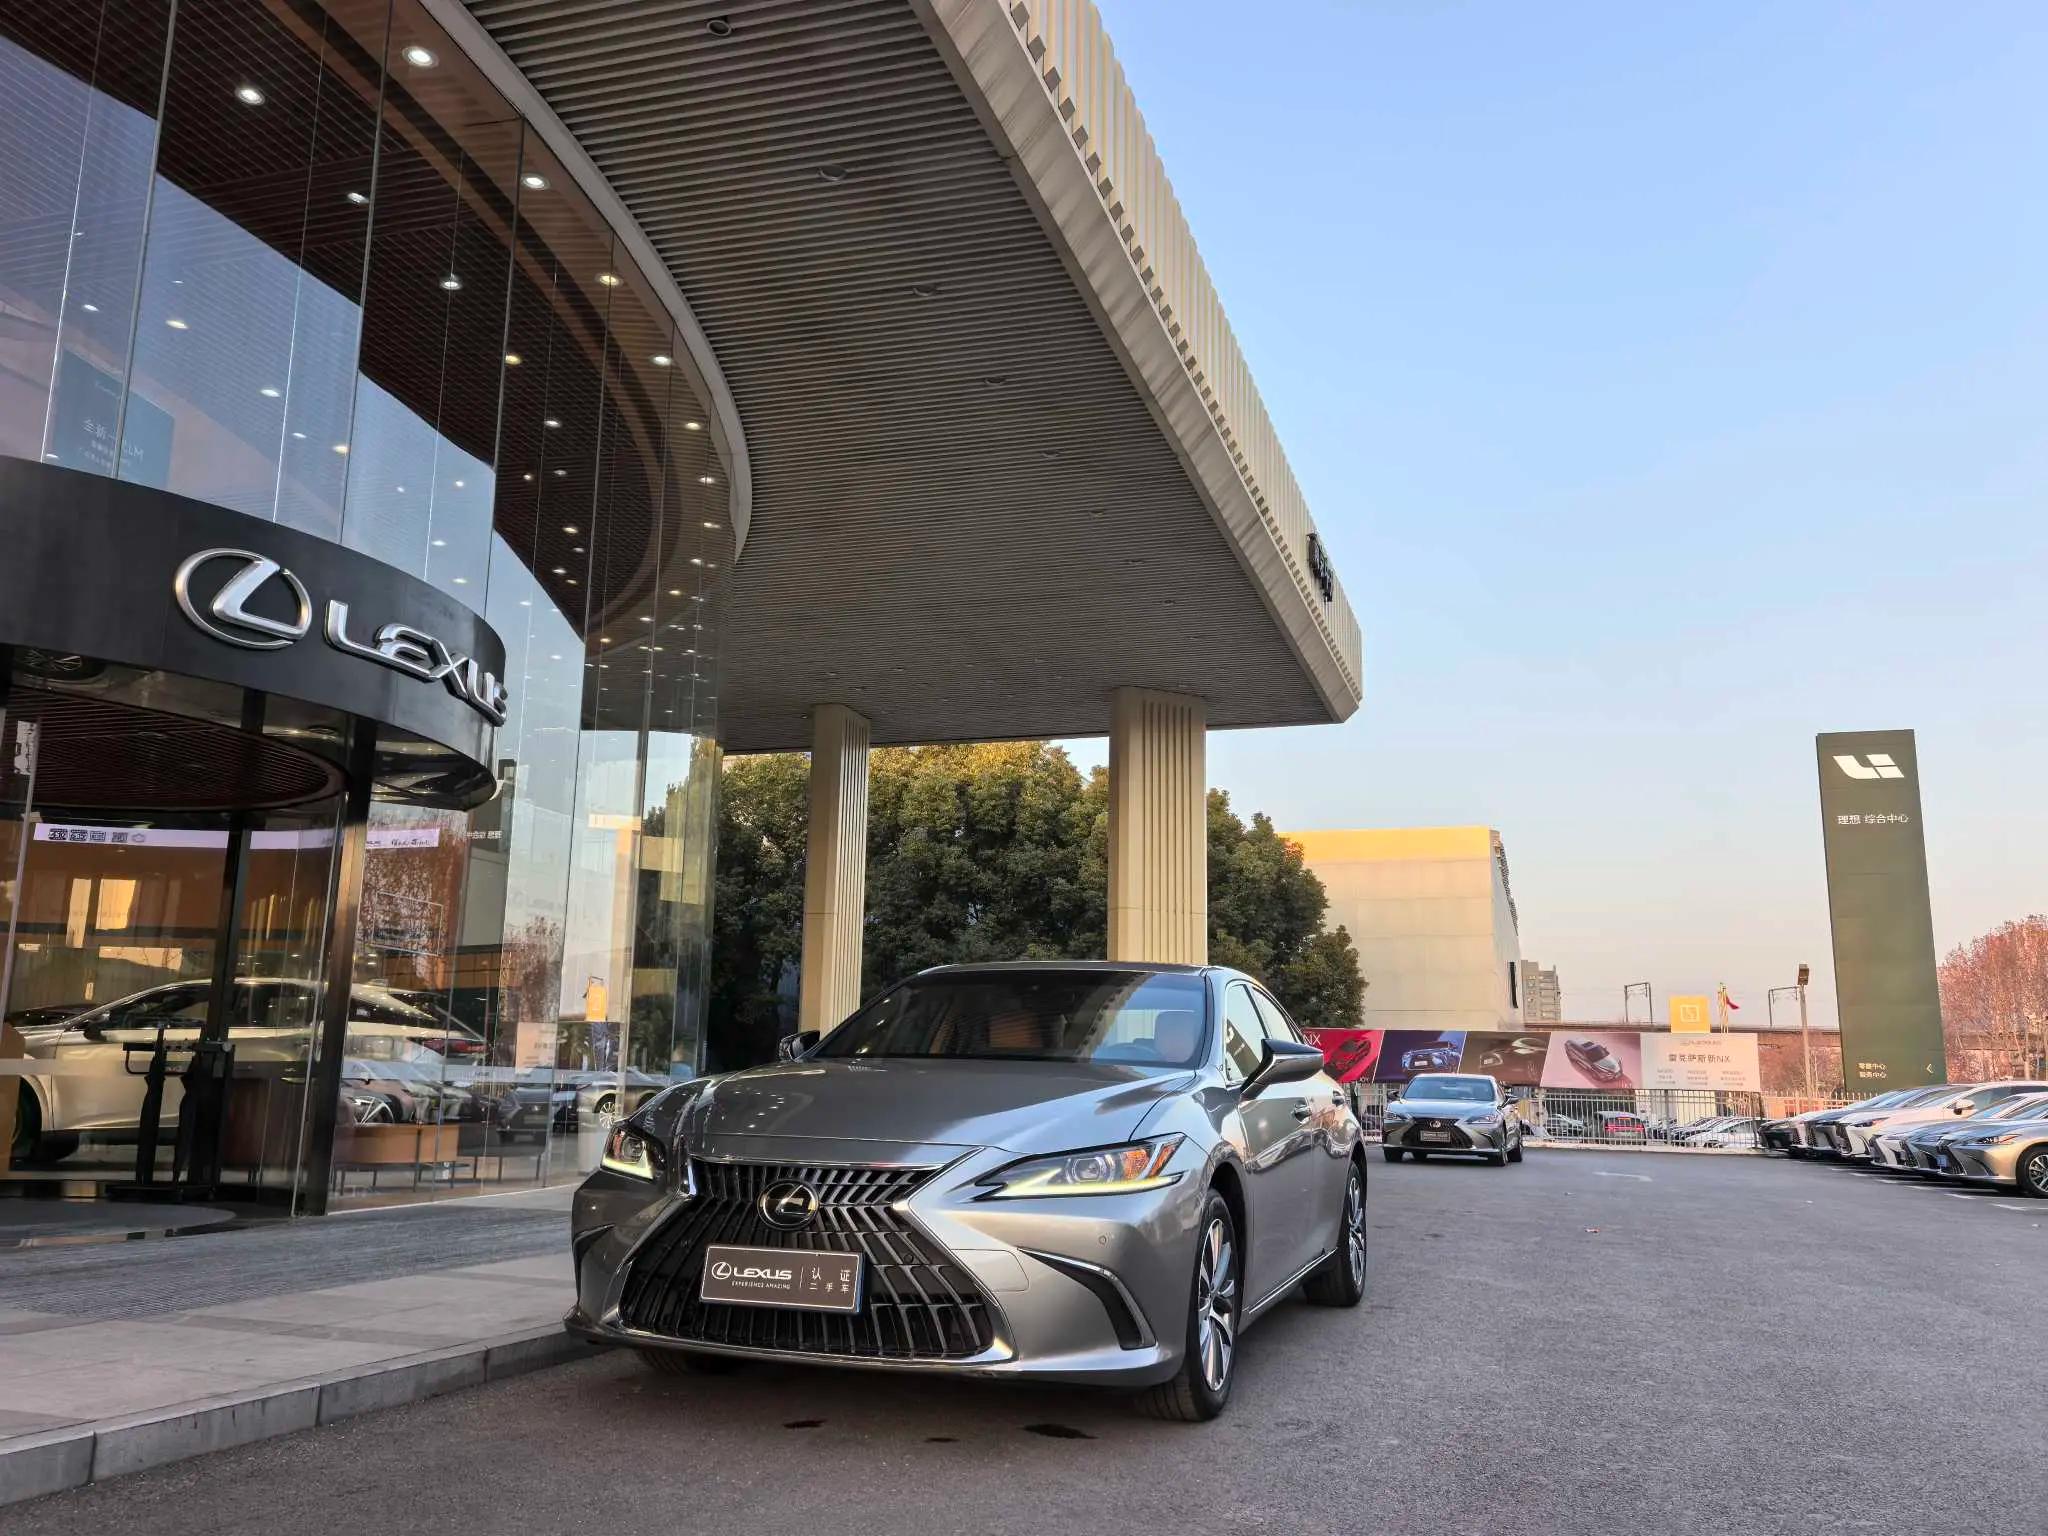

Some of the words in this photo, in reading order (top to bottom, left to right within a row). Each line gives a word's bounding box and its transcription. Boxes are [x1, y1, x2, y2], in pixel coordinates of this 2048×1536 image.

[1864, 813, 1909, 825] 综合中心
[734, 1267, 792, 1280] LEXUS
[811, 1267, 851, 1282] 认证
[732, 1281, 764, 1289] EXPERIENCE
[765, 1282, 791, 1290] AMAZING
[809, 1282, 850, 1294] 二手车
